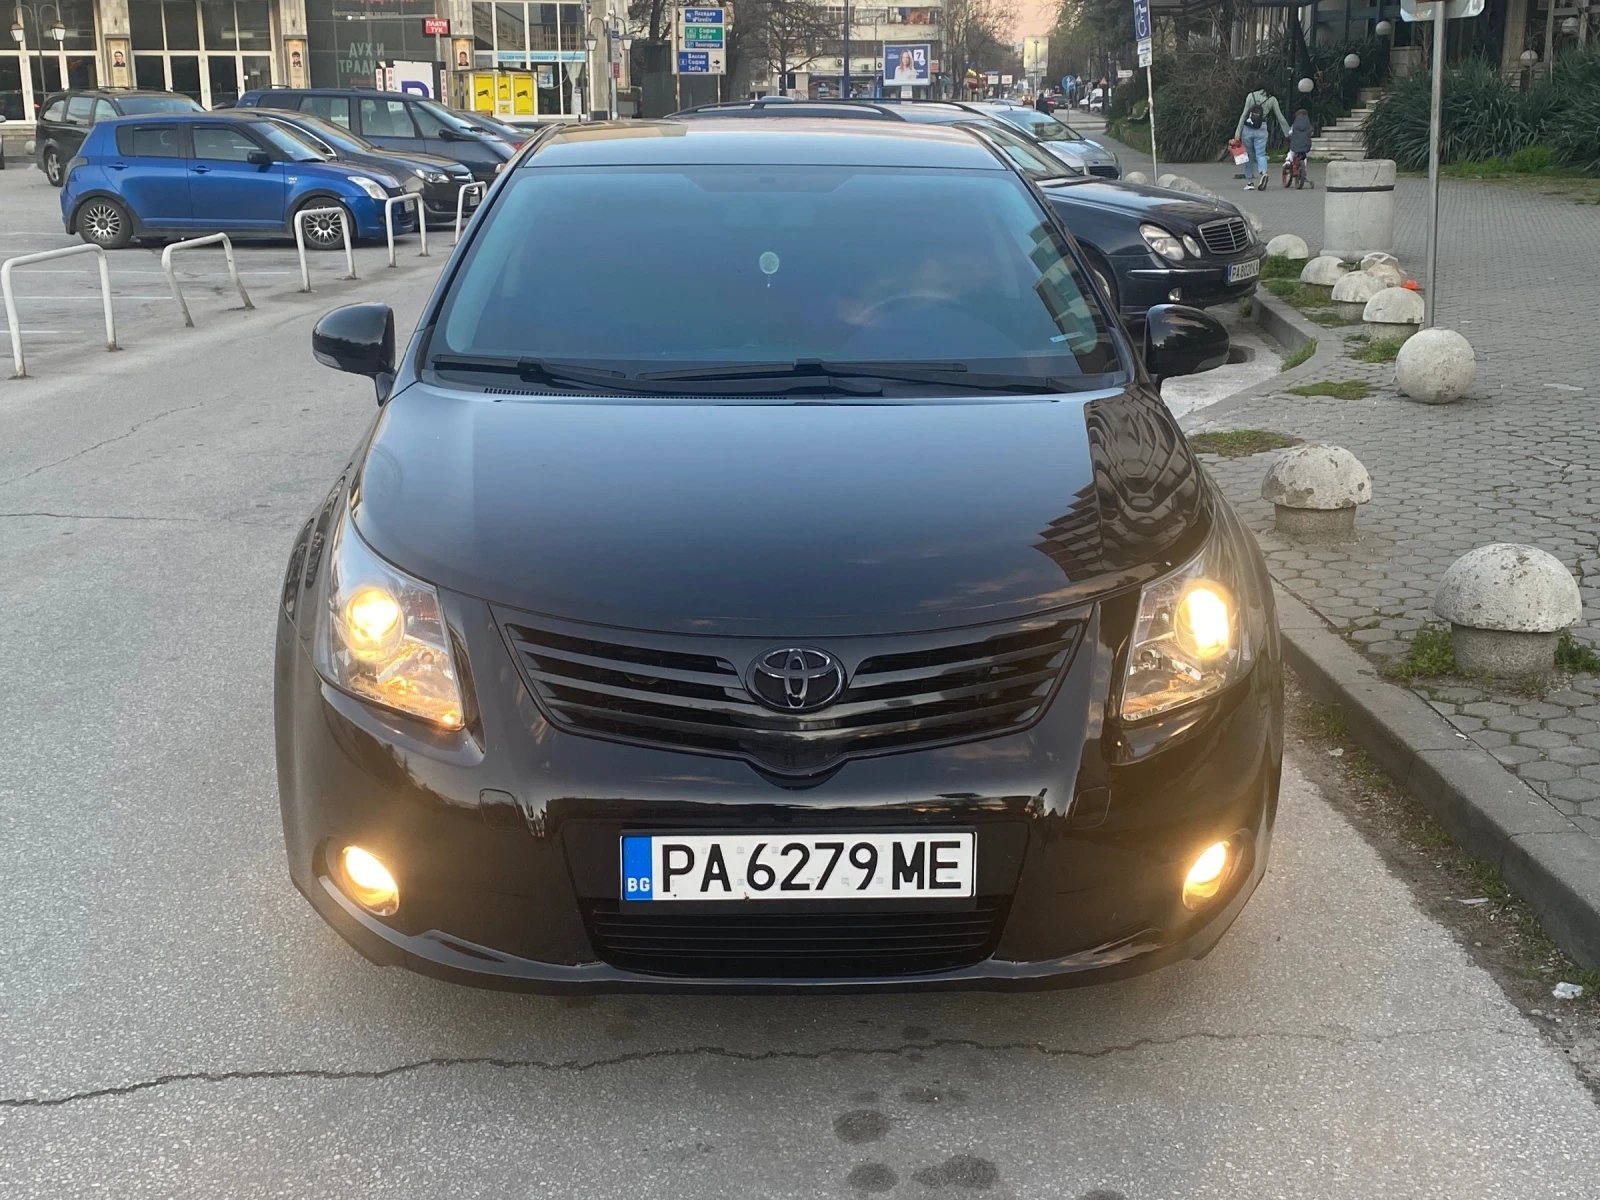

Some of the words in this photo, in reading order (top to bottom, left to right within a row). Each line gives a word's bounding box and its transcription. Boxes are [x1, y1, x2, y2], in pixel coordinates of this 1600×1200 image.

[348, 42, 373, 58] ДУХ
[376, 43, 384, 56] И
[662, 843, 732, 893] PA
[746, 842, 878, 892] 6279
[891, 841, 962, 891] ME
[627, 877, 650, 892] BG
